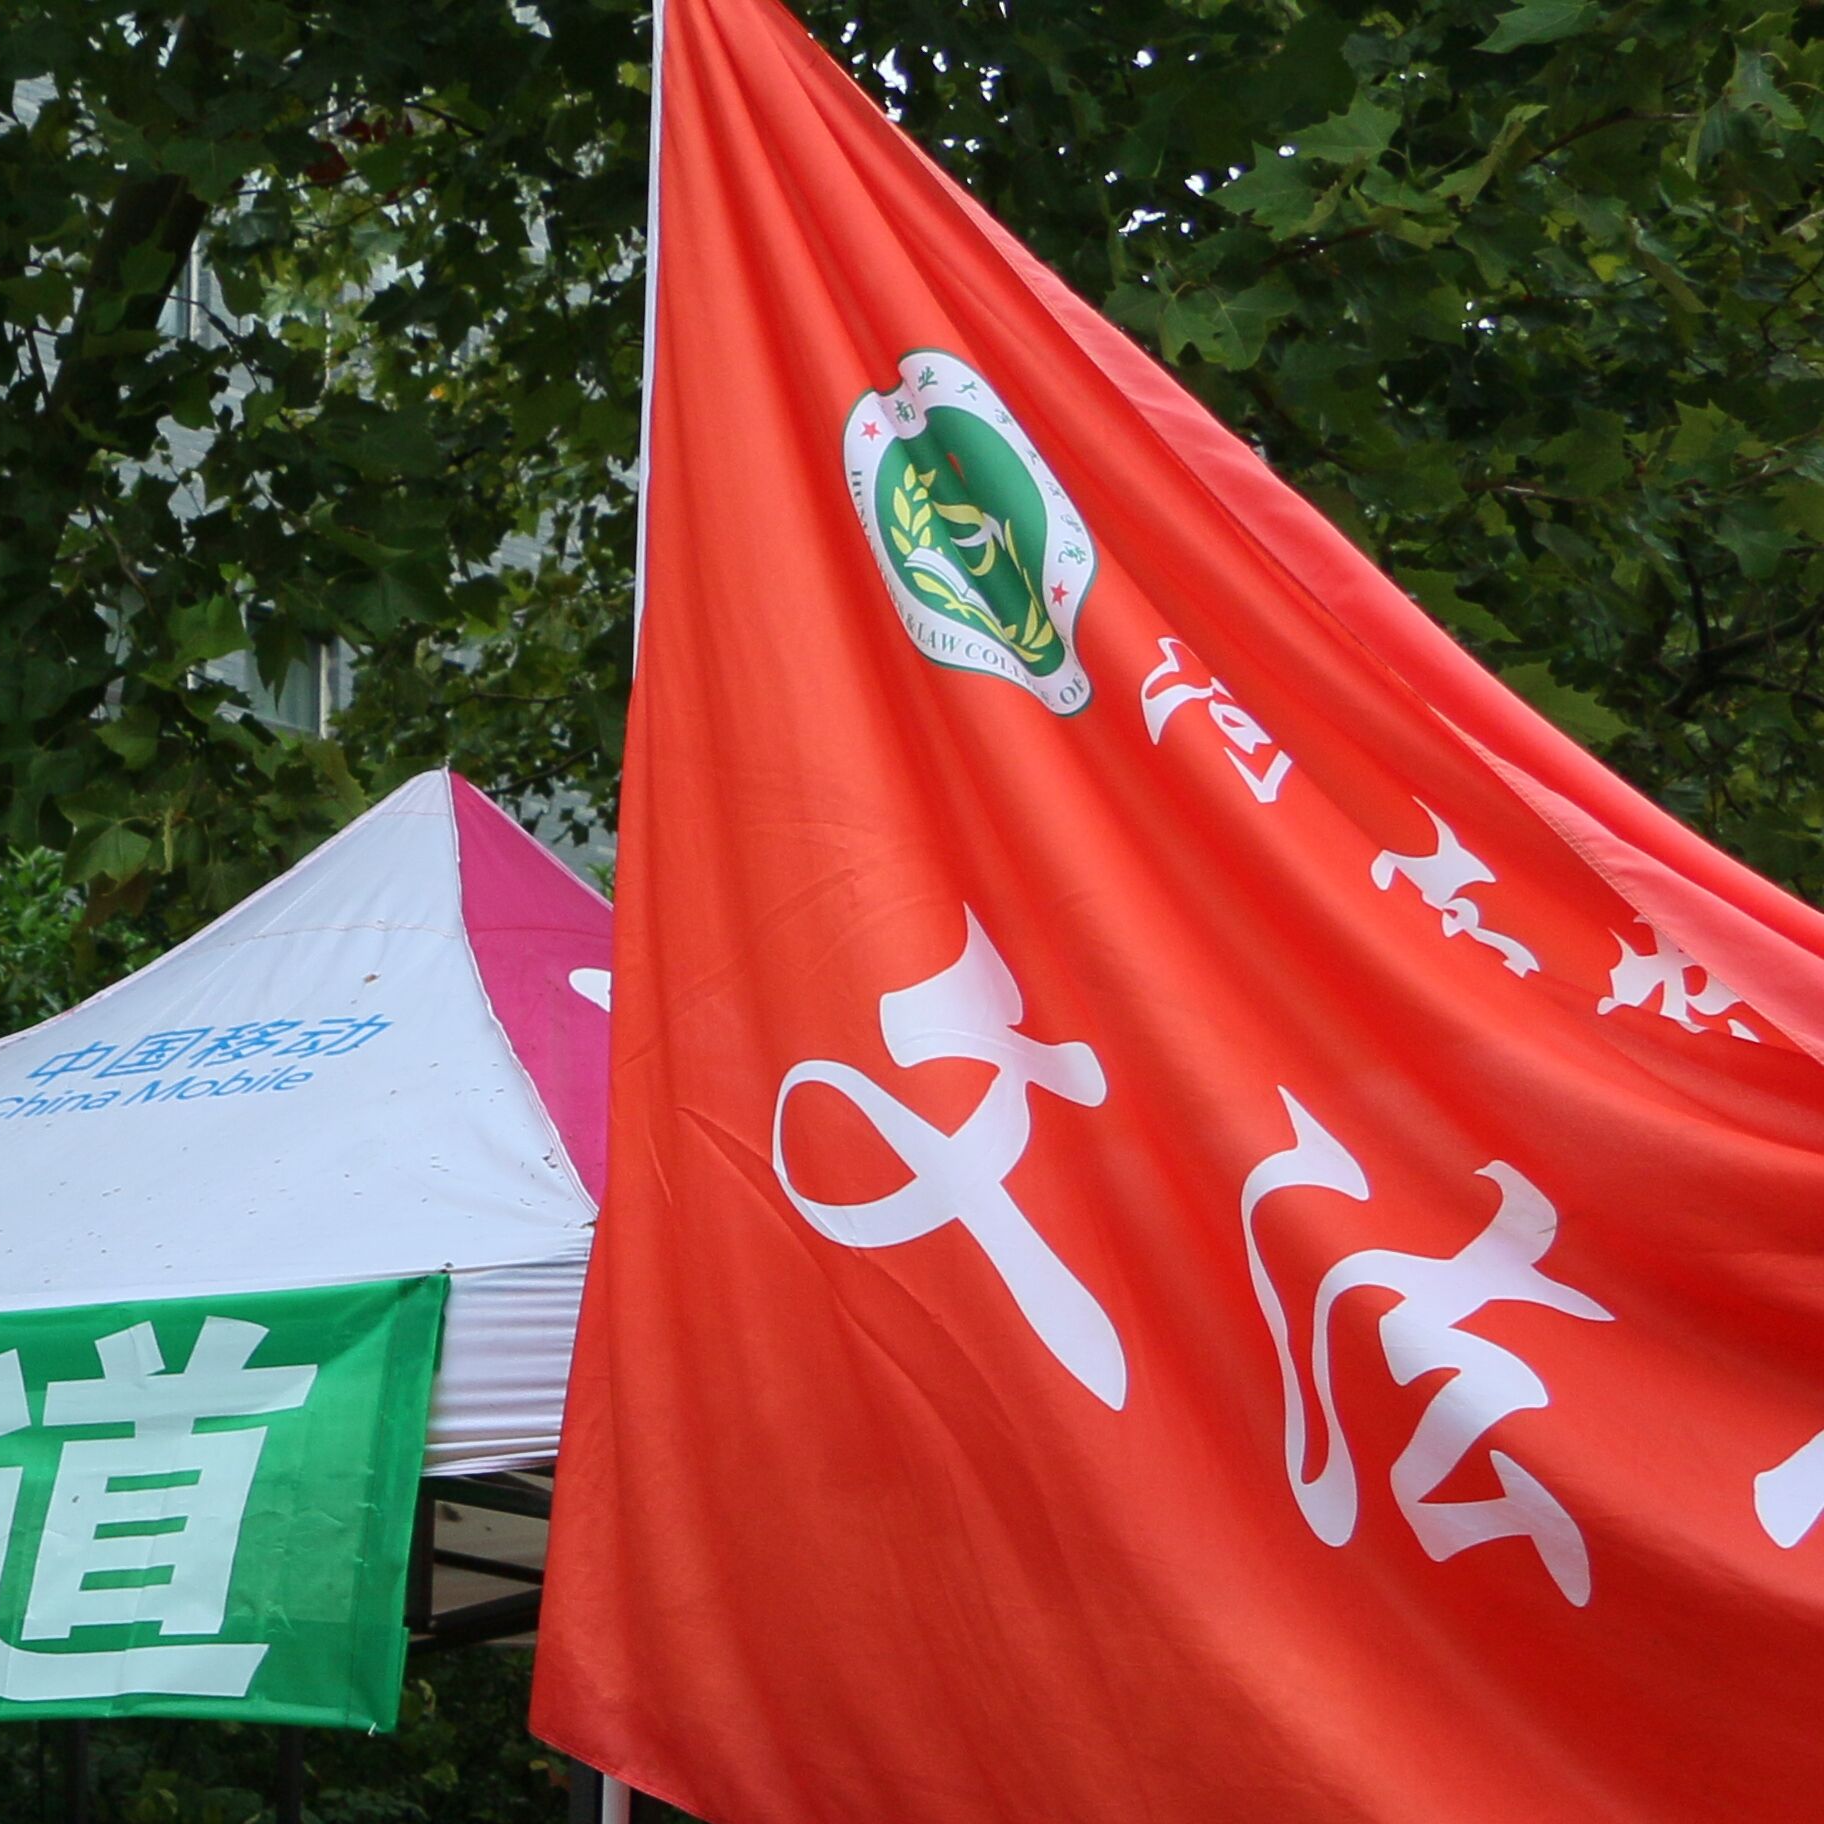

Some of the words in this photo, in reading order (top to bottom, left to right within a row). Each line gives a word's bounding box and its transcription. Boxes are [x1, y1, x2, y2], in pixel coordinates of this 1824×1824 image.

[30, 1013, 393, 1086] 中国移动
[122, 1066, 315, 1109] Mobile
[770, 904, 1824, 1611] 文法
